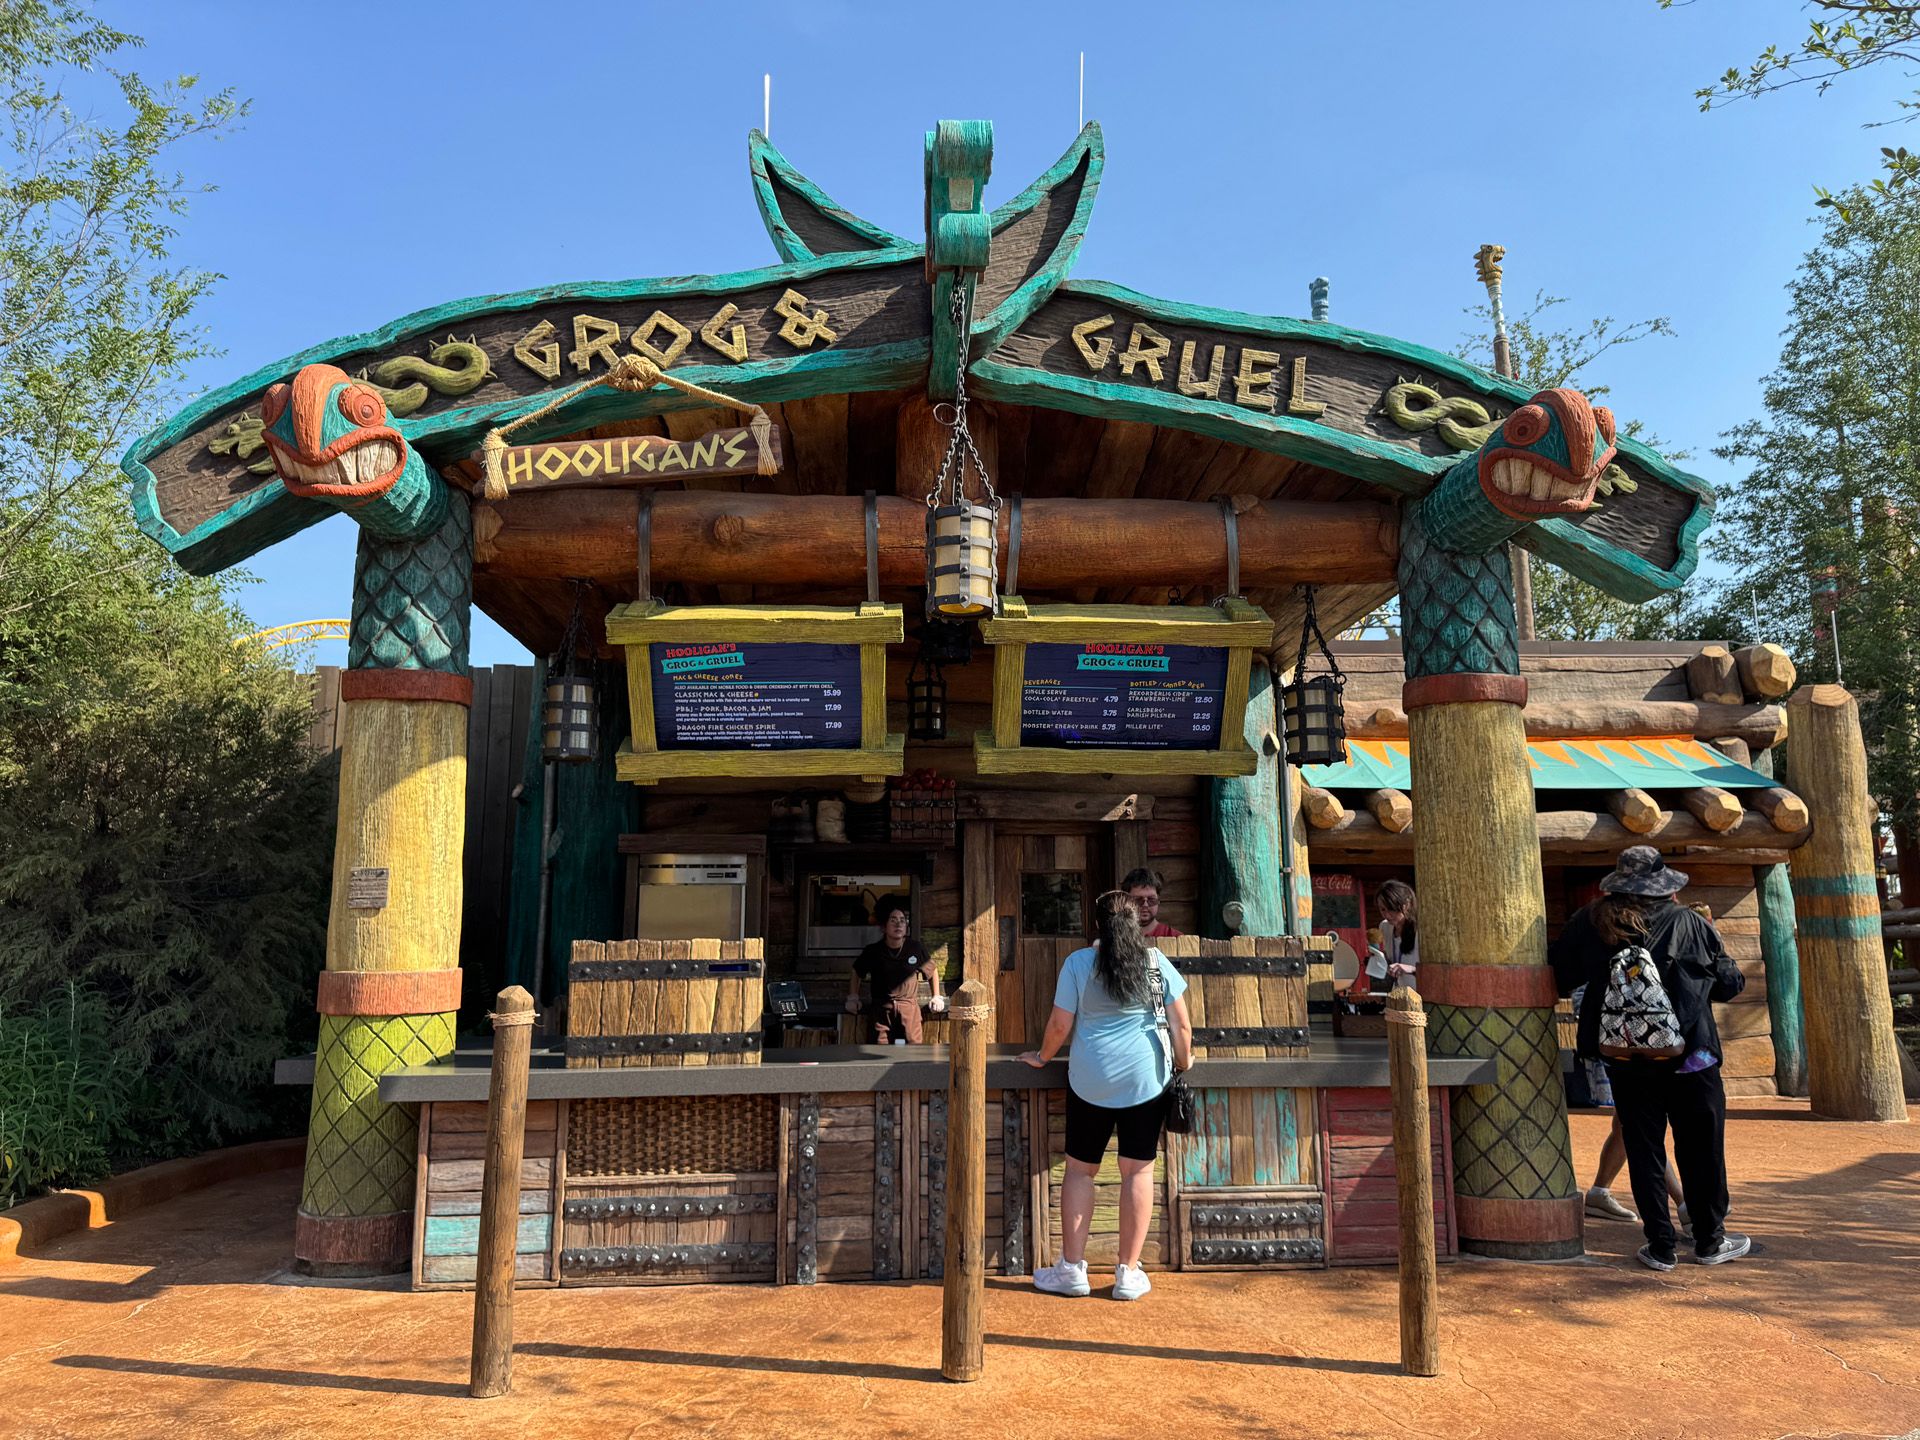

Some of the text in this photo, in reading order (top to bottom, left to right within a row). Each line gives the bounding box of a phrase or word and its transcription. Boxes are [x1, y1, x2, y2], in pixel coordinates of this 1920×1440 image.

[514, 288, 837, 380] GROG &
[1072, 314, 1327, 414] GRUEL
[507, 430, 748, 485] HOOLIGAN'S
[666, 643, 736, 658] HOOLIGAN'S
[1086, 643, 1164, 655] HOOLIGAN'S
[666, 660, 696, 670] GROG
[706, 656, 741, 666] GRUEL
[1083, 658, 1115, 666] GROG
[1127, 659, 1164, 668] GRUEL
